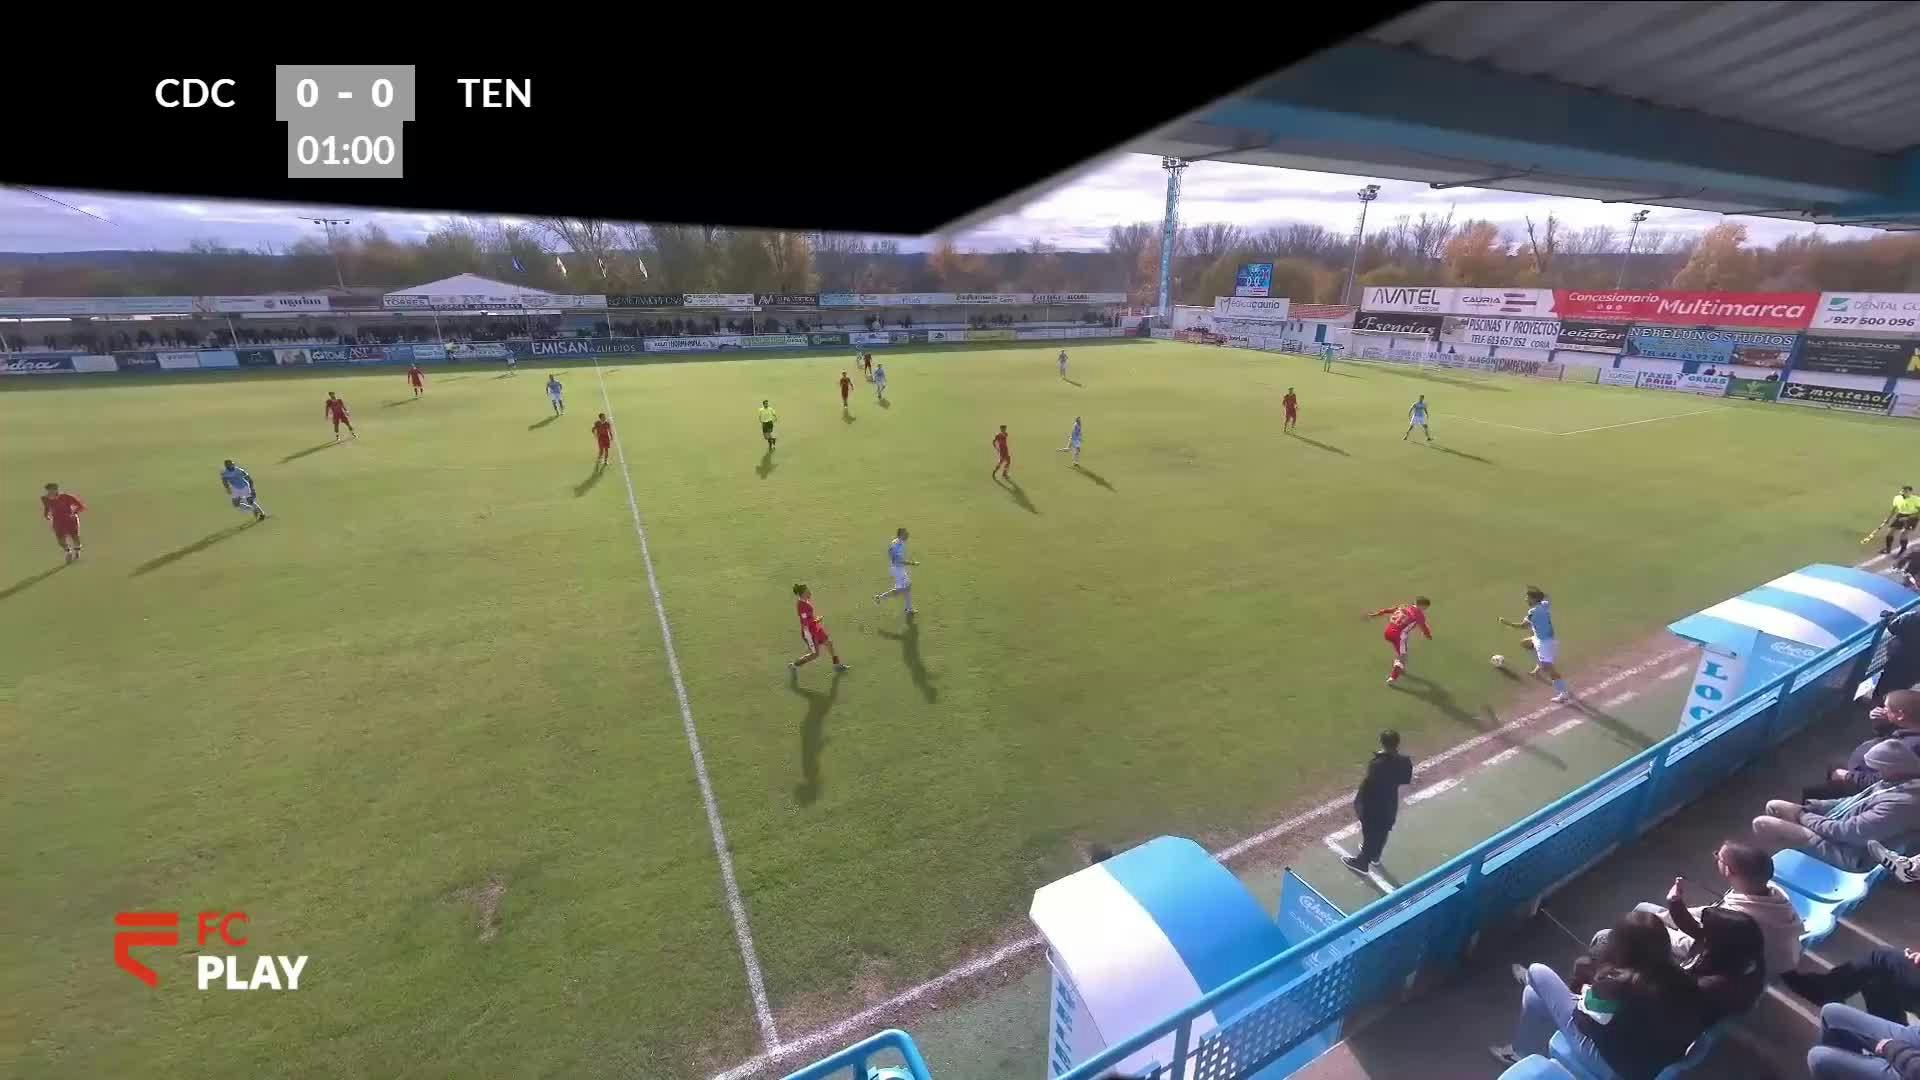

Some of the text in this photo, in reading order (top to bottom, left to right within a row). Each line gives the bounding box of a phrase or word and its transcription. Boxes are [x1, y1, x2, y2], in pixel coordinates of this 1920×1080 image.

[1371, 288, 1441, 305] AVATEL
[1462, 296, 1501, 304] CAURIA
[1568, 292, 1806, 318] Concesionario Multimarca
[1854, 301, 1897, 311] DENTAL
[1468, 318, 1559, 336] PISCINAS Y PROYECTOS
[1832, 316, 1915, 327] 927 500 096
[1629, 327, 1720, 342] NEBELUNG
[1721, 332, 1793, 346] STUDIOS
[531, 341, 588, 355] EMISAN
[1809, 388, 1893, 403] montesol
